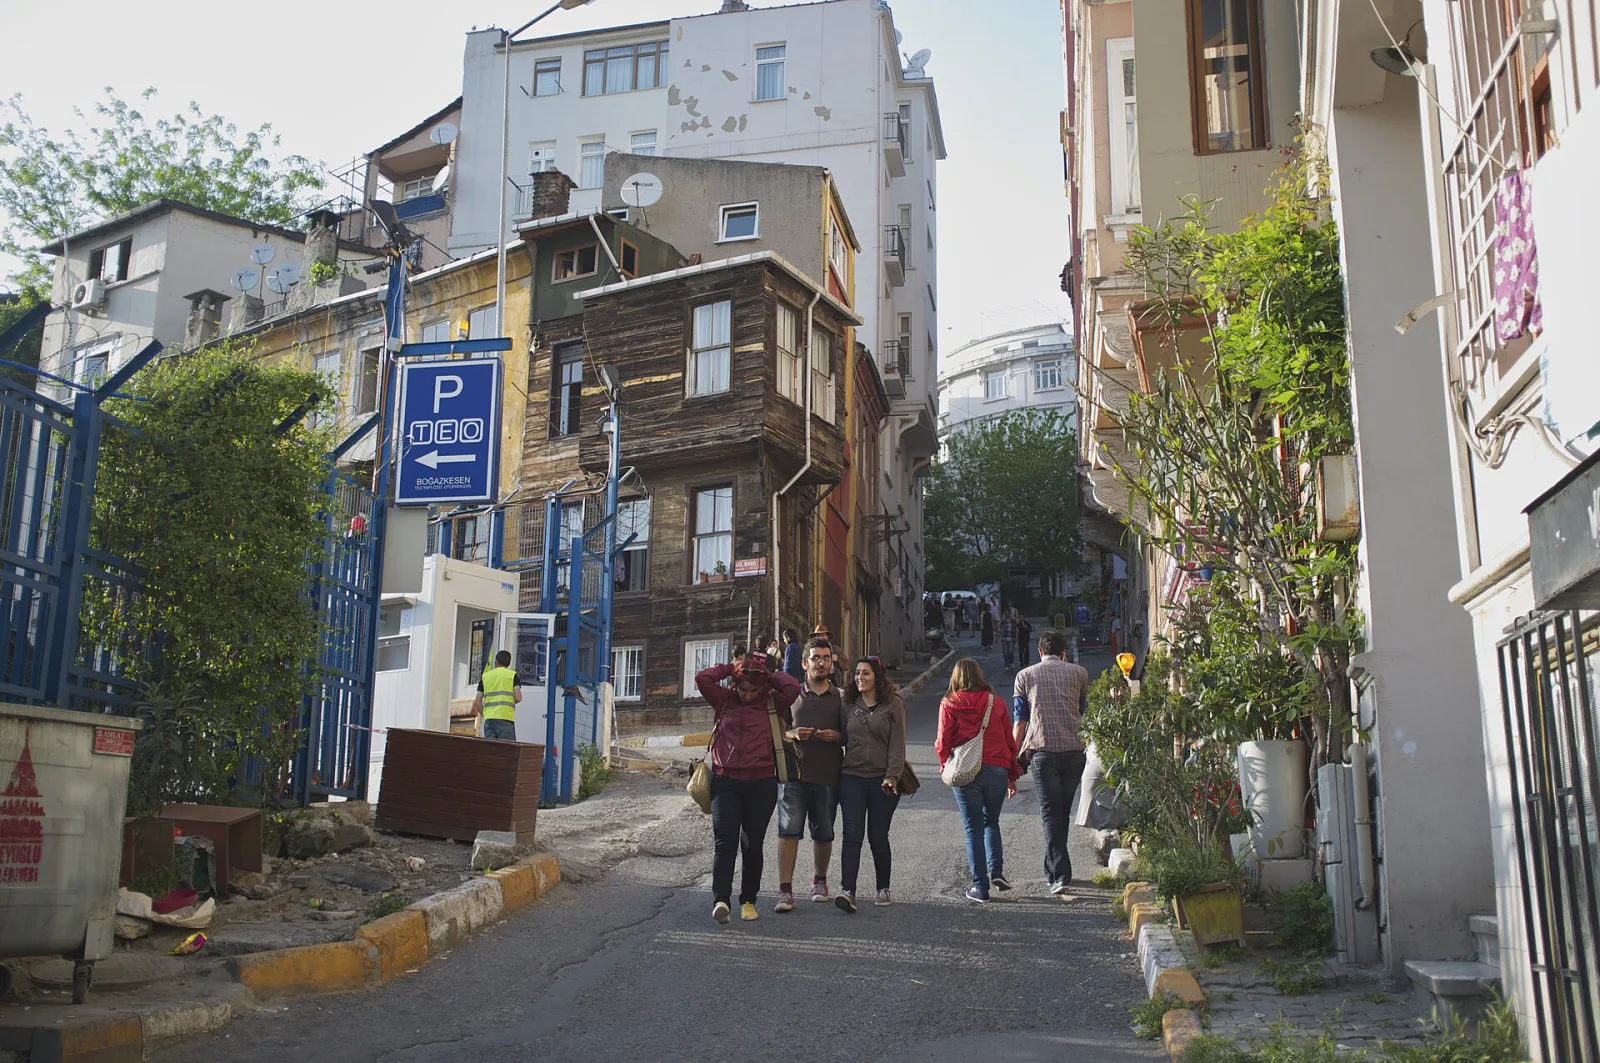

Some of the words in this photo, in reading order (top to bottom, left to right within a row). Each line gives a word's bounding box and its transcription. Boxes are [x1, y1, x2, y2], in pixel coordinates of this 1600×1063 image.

[433, 375, 464, 414] P
[413, 421, 481, 443] TEO
[416, 476, 471, 486] BOĞAZKESEN
[103, 731, 126, 740] AHLAT
